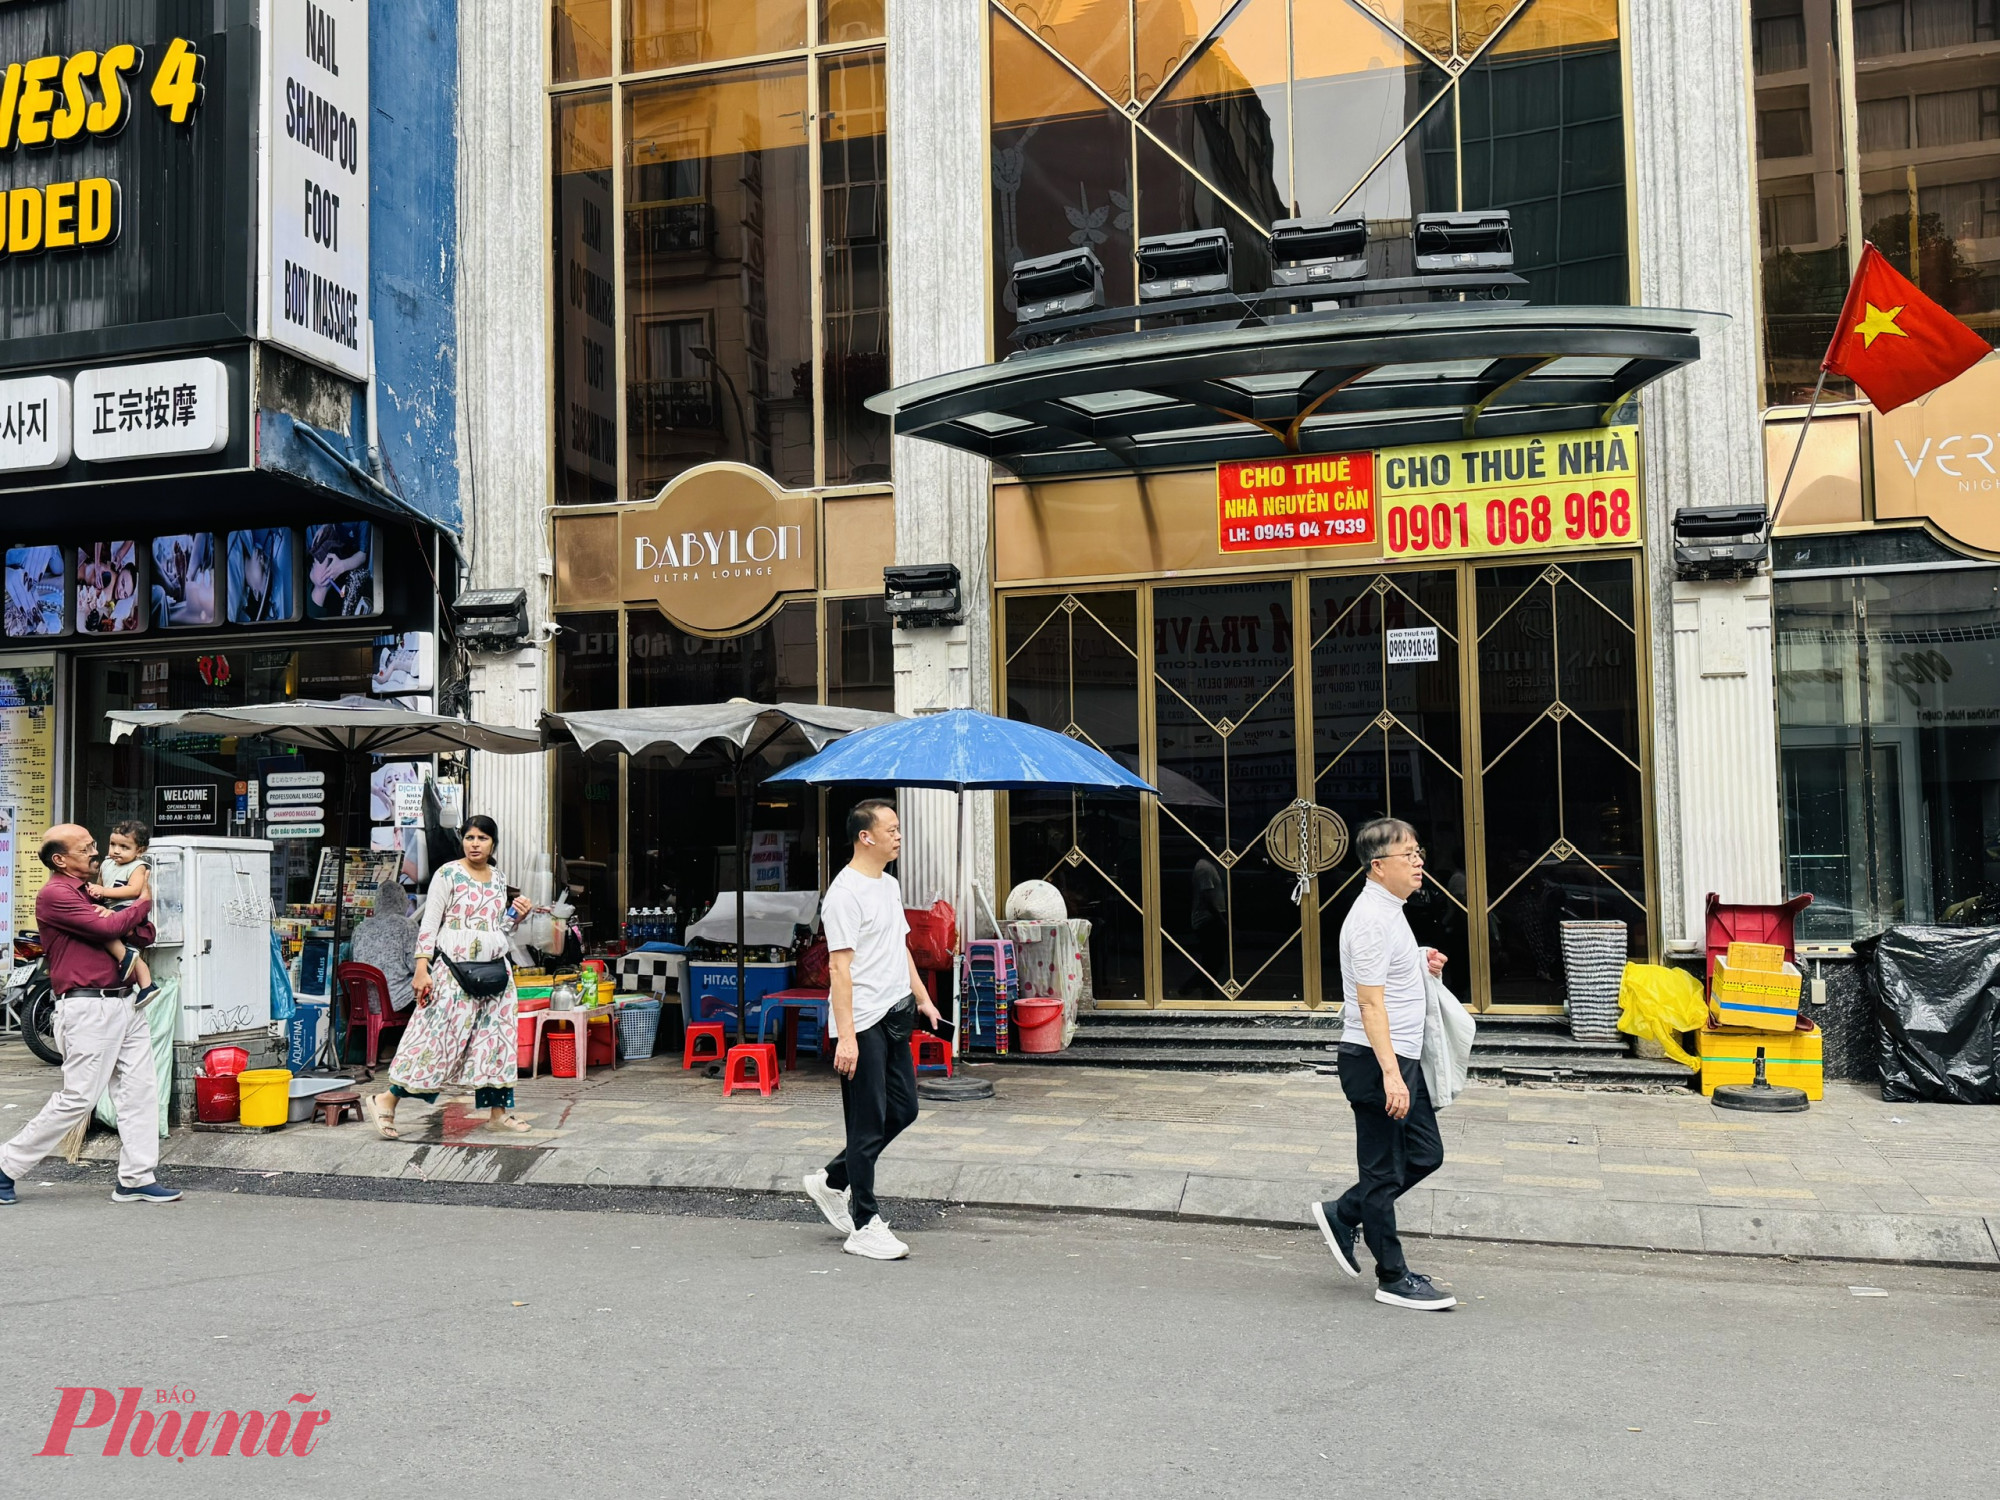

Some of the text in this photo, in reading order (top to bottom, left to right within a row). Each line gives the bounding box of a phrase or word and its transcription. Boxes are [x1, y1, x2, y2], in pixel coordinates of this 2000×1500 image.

[305, 0, 339, 77] NAIL
[151, 38, 197, 122] 4
[286, 77, 357, 175] SHAMPOO
[0, 177, 112, 255] DED
[305, 179, 339, 252] FOOT
[285, 259, 357, 351] BODY MASSAGE
[92, 383, 197, 434] 正宗按摩
[1239, 457, 1351, 488] CHO THUÊ
[1385, 437, 1630, 489] CHO THUÊ NHÀ
[1224, 485, 1369, 519] NHÀ NGUYÊN CĂN
[1388, 487, 1631, 554] 0901 068 968
[635, 525, 801, 570] BABYLON
[1228, 517, 1366, 542] LH: 0945 04 7939
[654, 567, 772, 583] ULTRA LOUNGE
[1389, 638, 1436, 658] 0909.910.961
[164, 789, 208, 801] WELCOME
[292, 1018, 304, 1065] AQUAFINA
